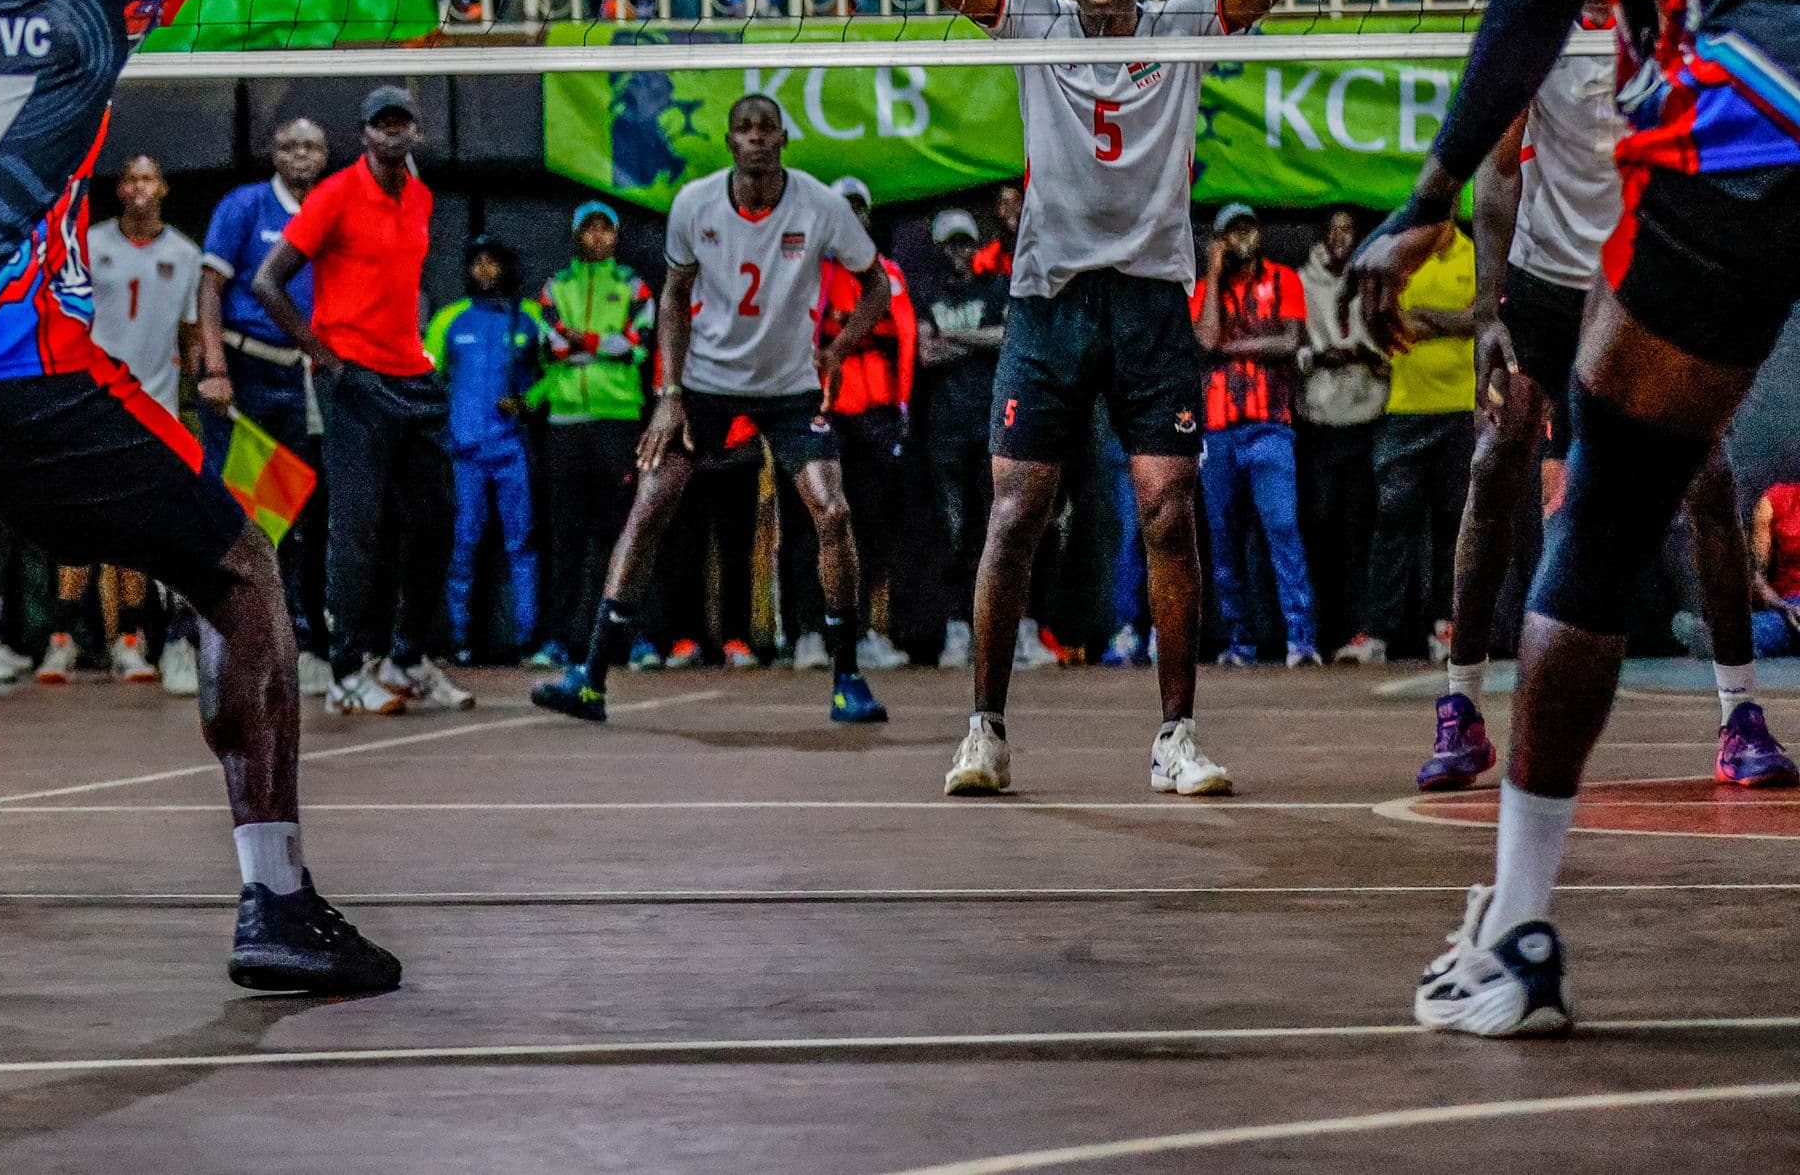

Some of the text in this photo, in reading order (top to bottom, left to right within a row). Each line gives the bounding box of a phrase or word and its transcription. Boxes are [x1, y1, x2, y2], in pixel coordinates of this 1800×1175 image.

[1135, 71, 1161, 90] KEN
[1094, 100, 1122, 161] 5
[1265, 68, 1452, 152] KCB
[128, 279, 139, 319] 1
[738, 262, 760, 316] 2
[1004, 399, 1018, 426] 5
